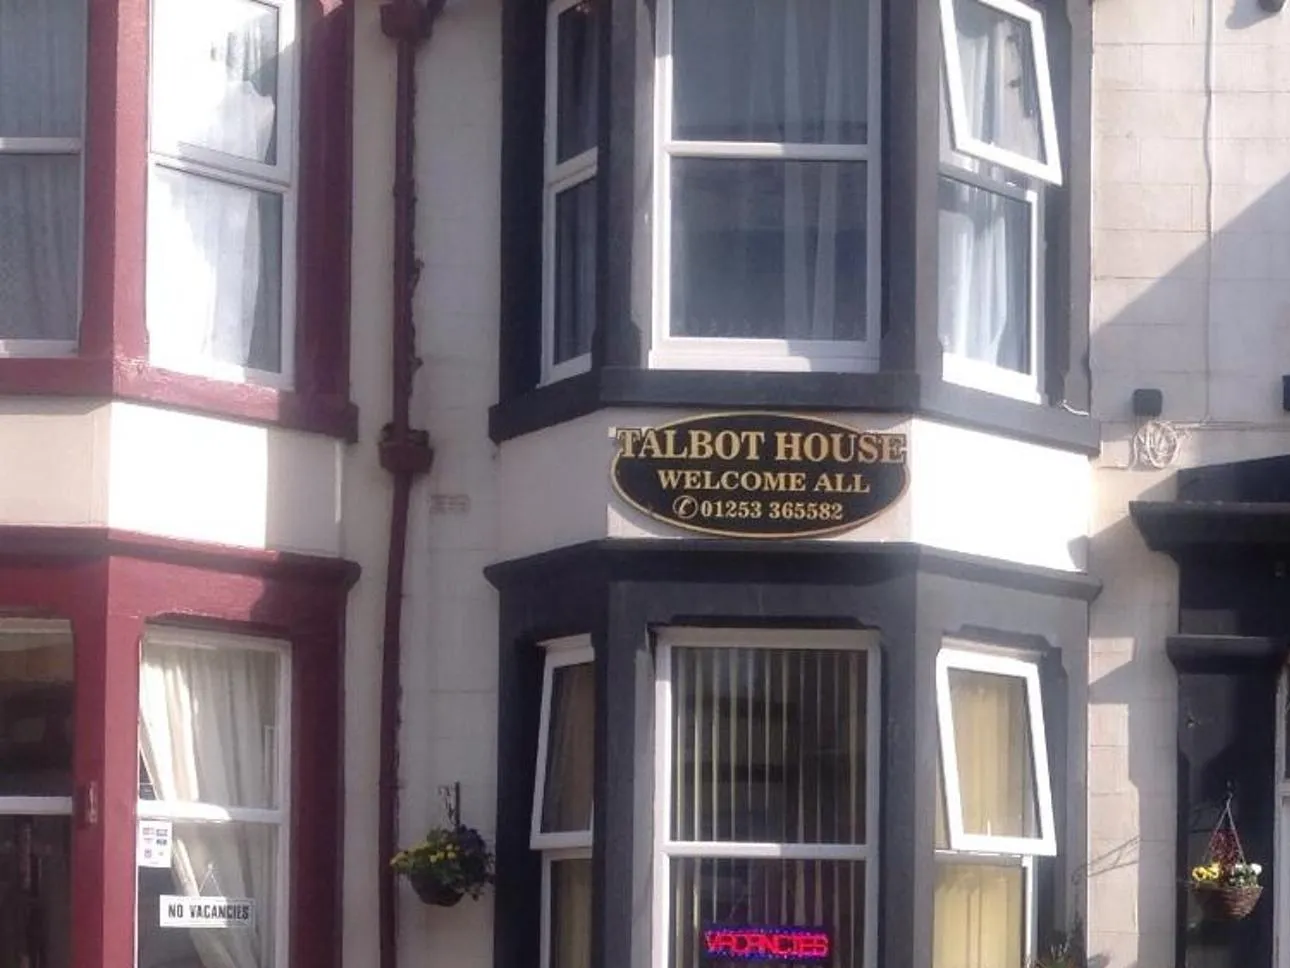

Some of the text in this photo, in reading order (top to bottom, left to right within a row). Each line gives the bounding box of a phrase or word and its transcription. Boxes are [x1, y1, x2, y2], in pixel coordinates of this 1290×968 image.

[615, 428, 907, 464] TALBOT HOUSE
[657, 469, 870, 493] WELCOME ALL
[701, 501, 843, 520] 01253 365582
[168, 904, 250, 920] NO VACANCIES
